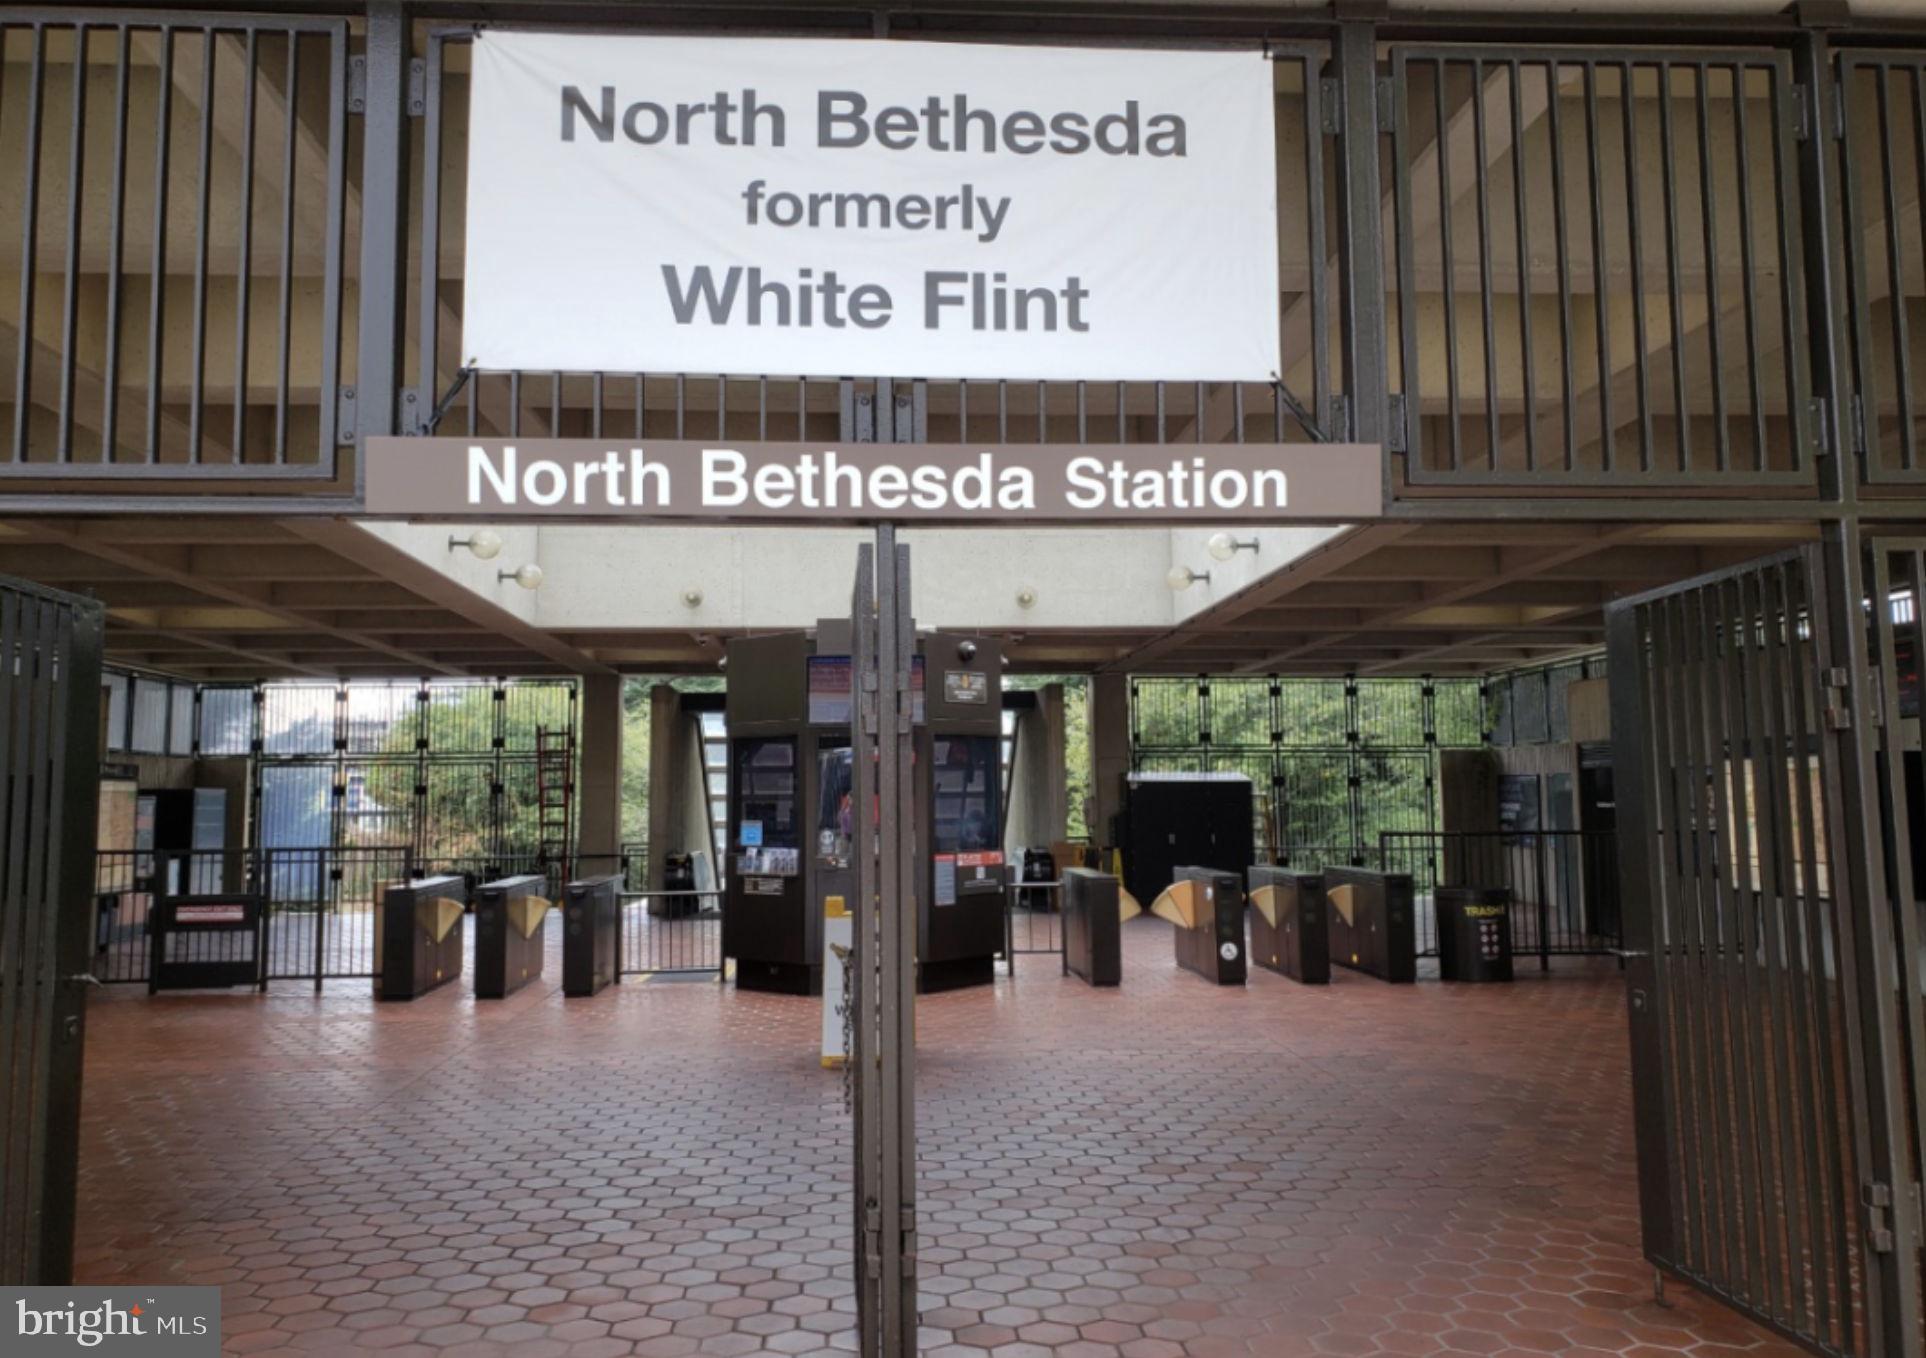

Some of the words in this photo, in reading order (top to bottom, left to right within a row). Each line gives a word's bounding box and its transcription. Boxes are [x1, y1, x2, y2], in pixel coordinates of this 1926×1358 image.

[561, 86, 785, 147] North
[817, 90, 1187, 157] Bethesda
[742, 180, 1011, 243] formerly
[662, 265, 892, 328] White
[925, 271, 1089, 332] Flint
[467, 445, 671, 506] North
[701, 448, 1036, 511] Bethesda
[1065, 456, 1288, 509] Station
